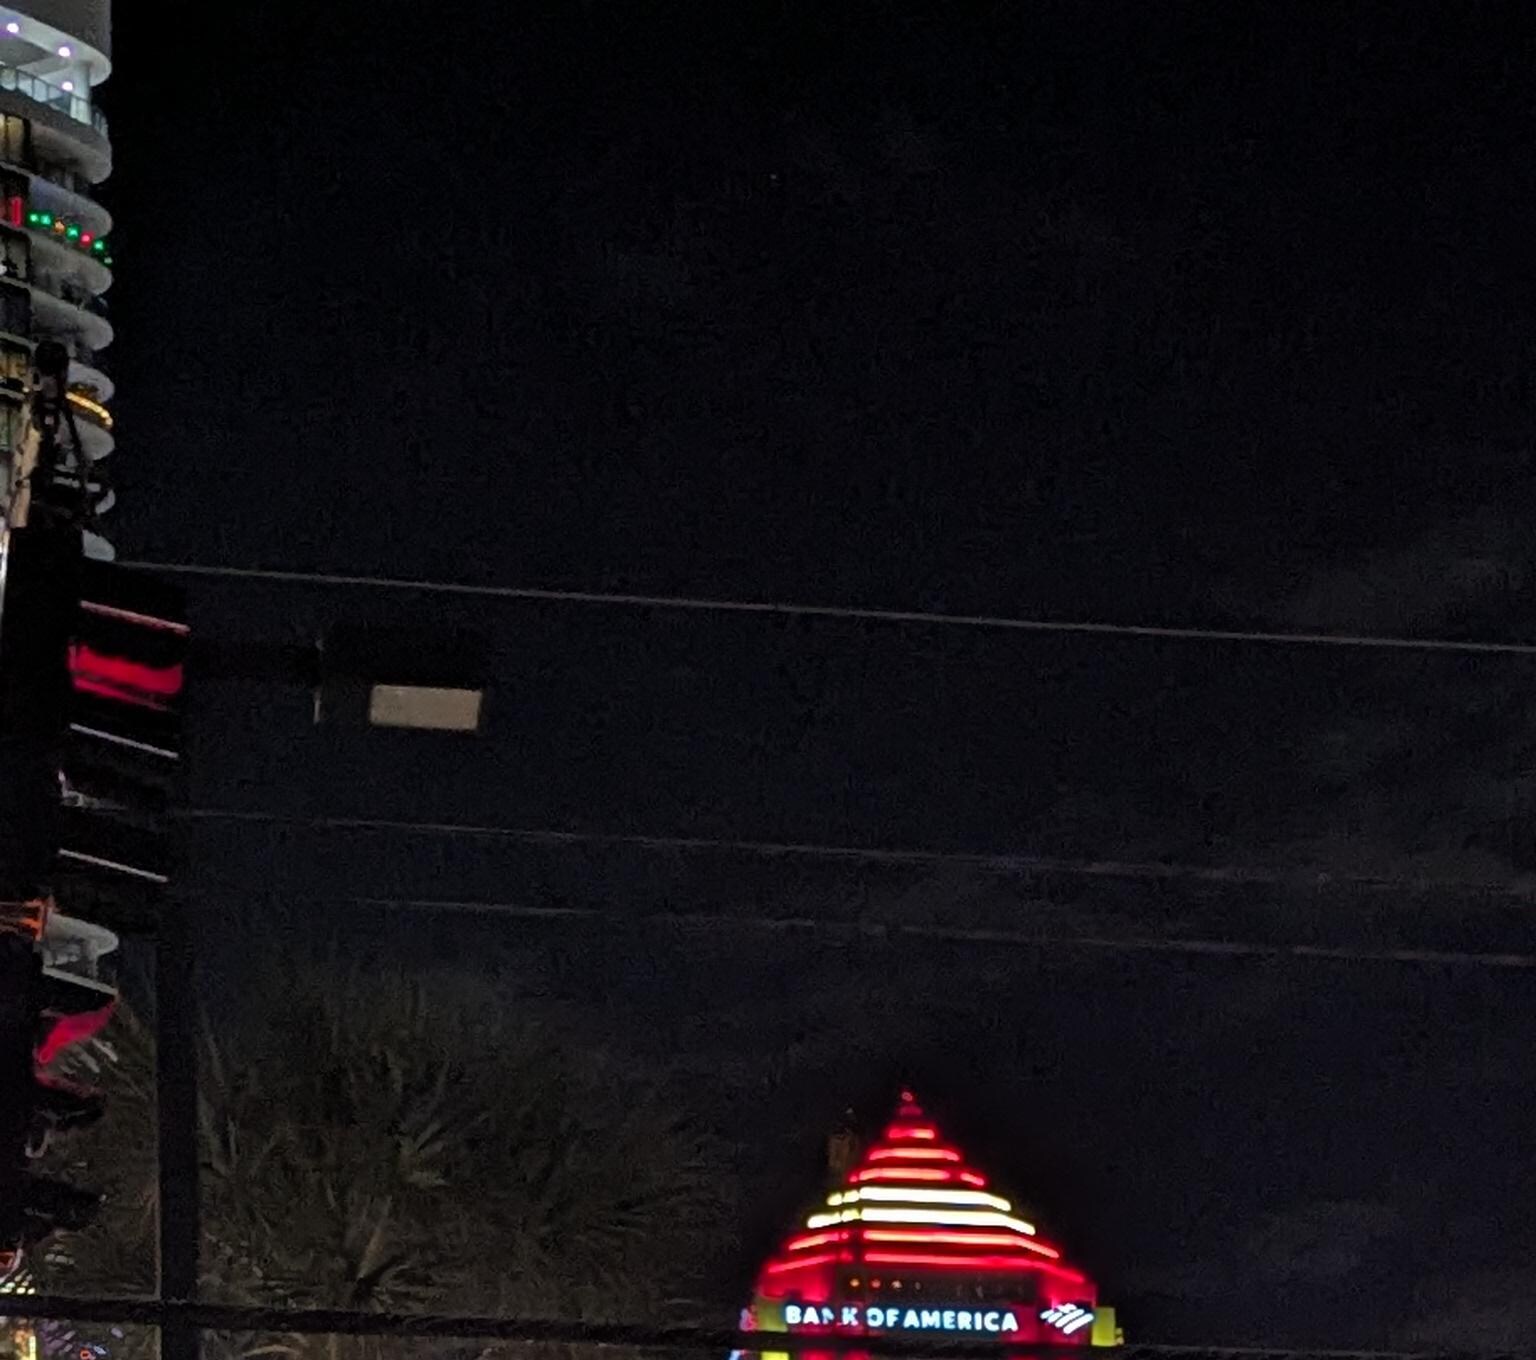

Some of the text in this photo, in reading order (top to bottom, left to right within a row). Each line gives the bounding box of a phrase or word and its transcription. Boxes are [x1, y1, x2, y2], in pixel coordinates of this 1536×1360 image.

[785, 1304, 1019, 1332] BANK OF AMERICA
